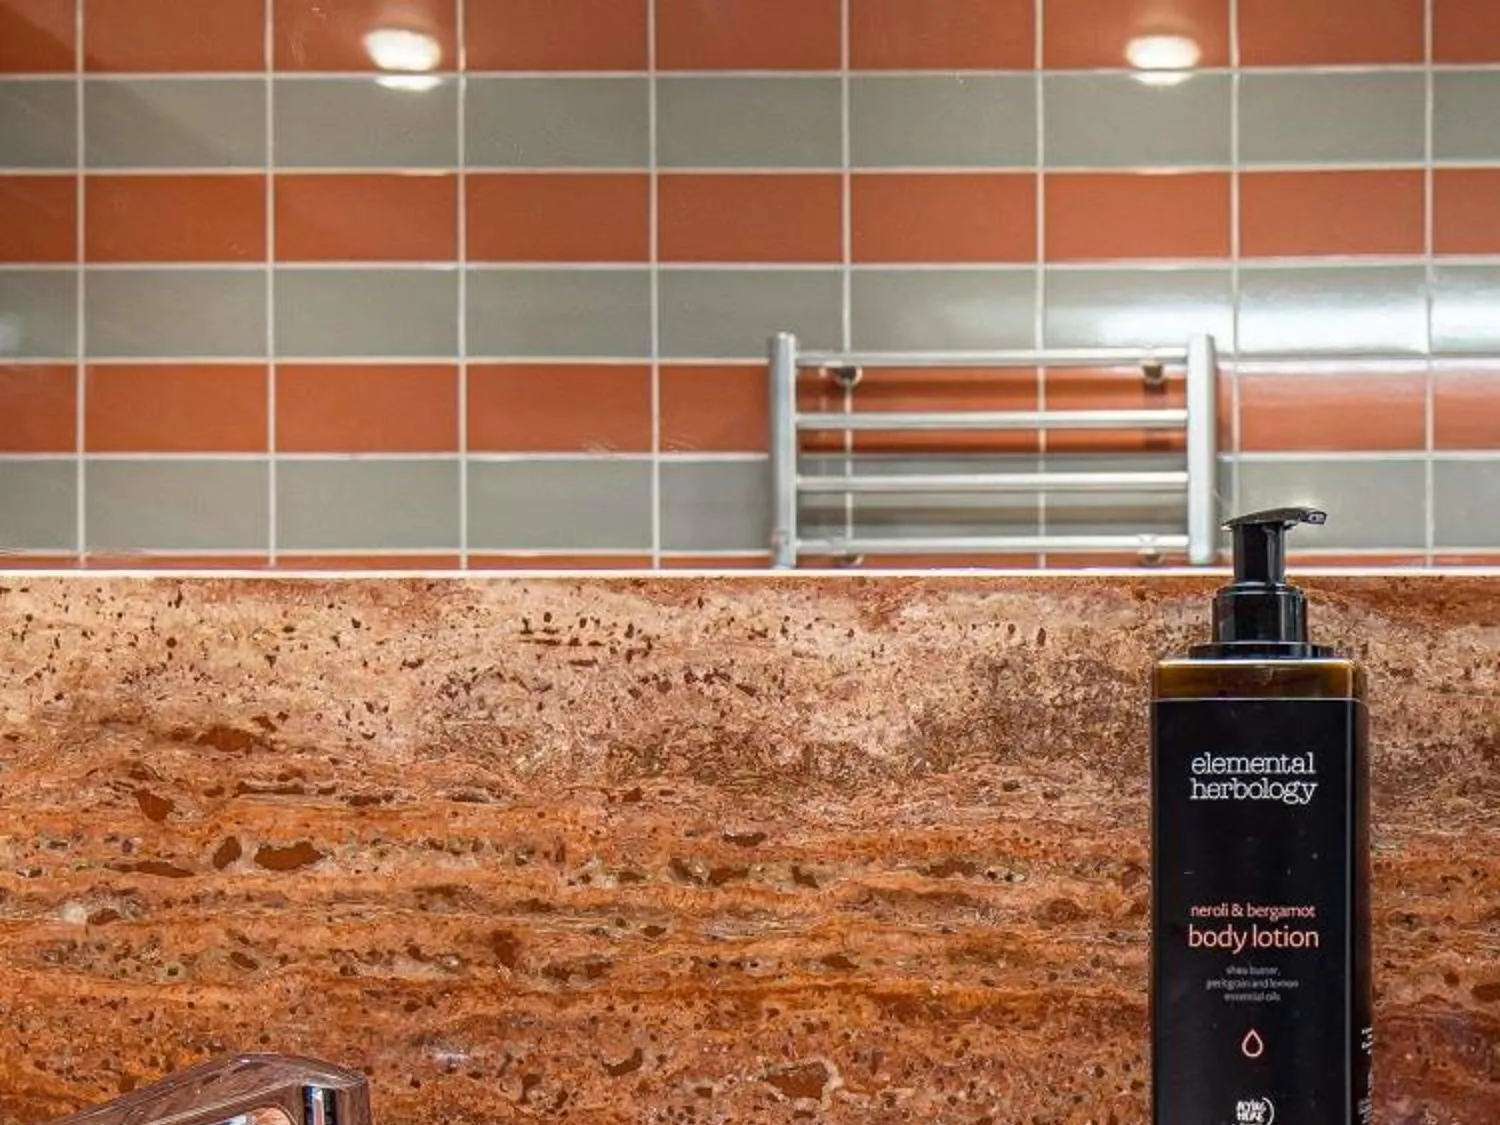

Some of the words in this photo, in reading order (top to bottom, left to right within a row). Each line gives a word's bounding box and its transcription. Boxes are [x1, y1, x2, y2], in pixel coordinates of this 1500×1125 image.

[1191, 752, 1316, 774] elemental
[1189, 778, 1318, 804] herbology
[1190, 903, 1229, 917] neroli
[1231, 903, 1244, 917] &
[1247, 902, 1316, 921] bergamot
[1188, 924, 1248, 955] body
[1253, 924, 1319, 948] lotion
